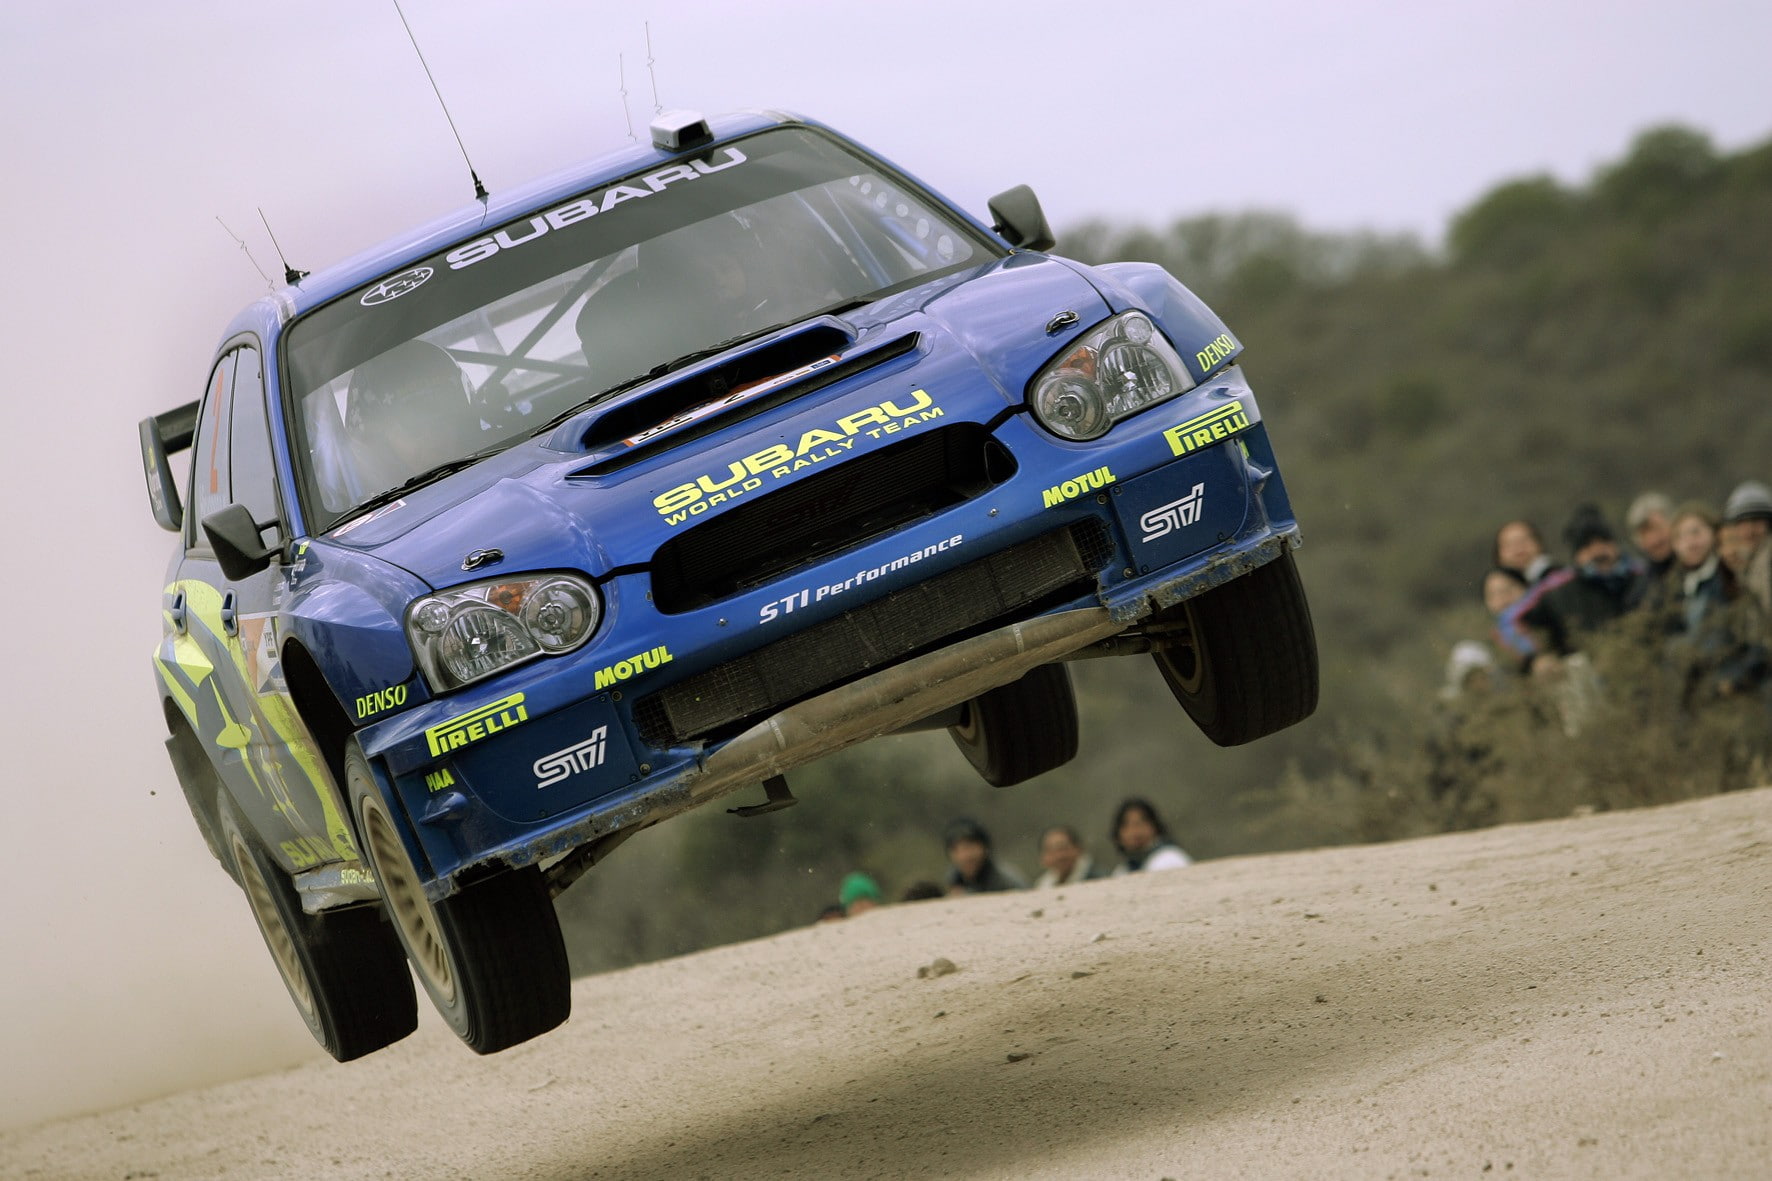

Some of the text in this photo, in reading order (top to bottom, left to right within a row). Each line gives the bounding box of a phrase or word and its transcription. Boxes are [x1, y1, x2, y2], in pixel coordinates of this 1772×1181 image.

[446, 147, 747, 270] SUBARU
[1196, 333, 1236, 372] DENSO
[653, 388, 935, 515] SUBARU
[1162, 400, 1250, 457] PIRELLI
[664, 477, 762, 526] WORLD
[772, 438, 855, 480] RALLY
[866, 406, 945, 440] TEAM
[1041, 465, 1117, 509] MOTUL
[759, 534, 963, 624] STI Performance
[594, 645, 674, 690] MOTUL
[355, 684, 408, 719] DENSO
[424, 692, 529, 757] PIRELLI
